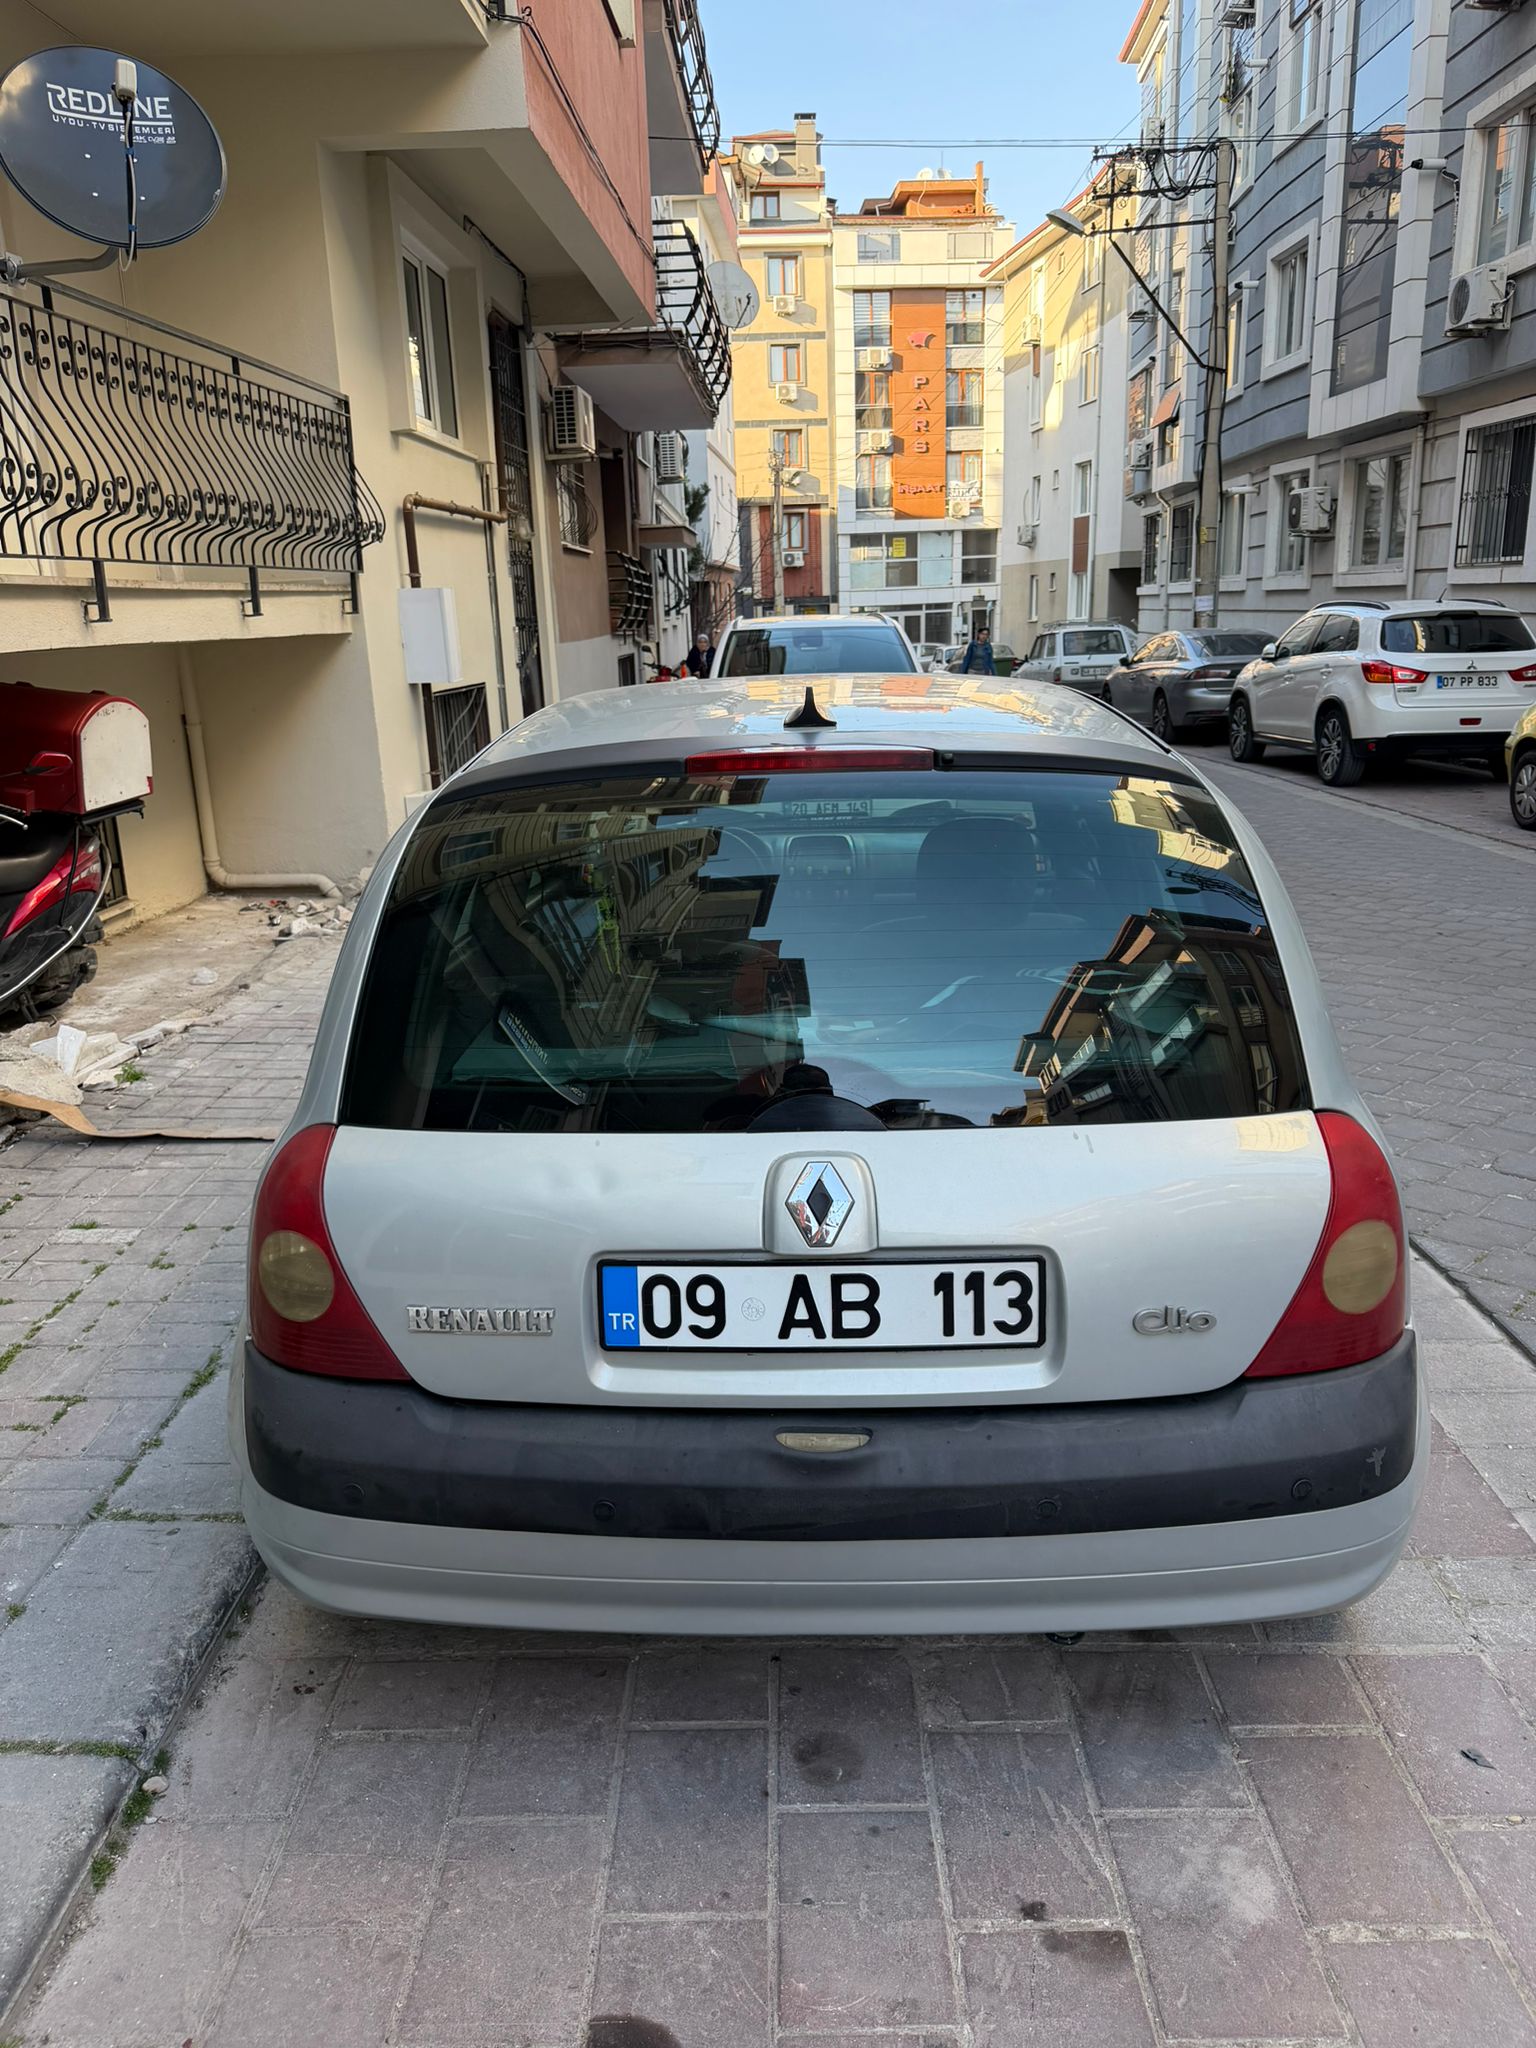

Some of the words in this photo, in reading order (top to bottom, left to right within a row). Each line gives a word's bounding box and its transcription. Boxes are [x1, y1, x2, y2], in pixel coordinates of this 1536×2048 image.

[46, 82, 173, 121] REDLNE
[913, 375, 930, 454] PARS
[1442, 676, 1456, 687] 07
[1460, 676, 1474, 687] PP
[1477, 675, 1498, 687] 833
[406, 1305, 556, 1337] RENAULT
[608, 1312, 636, 1331] TR
[641, 1273, 726, 1340] 09
[778, 1273, 881, 1340] AB
[934, 1269, 1034, 1338] 113
